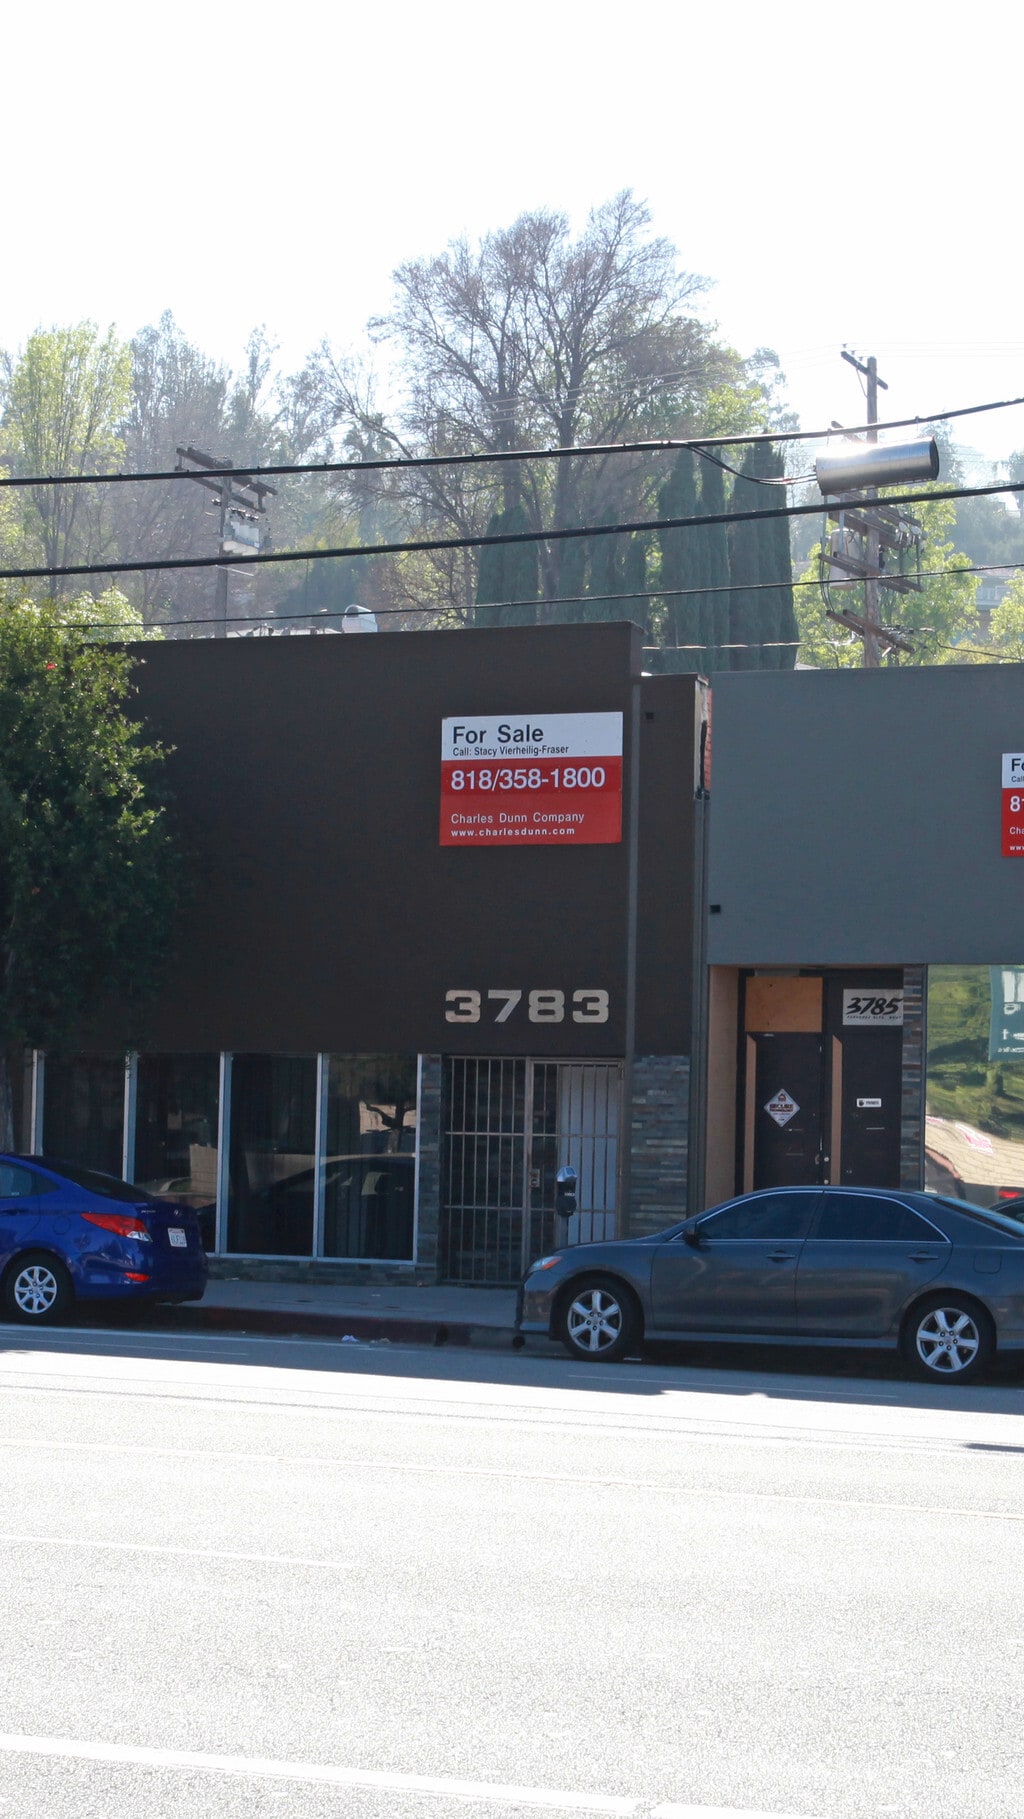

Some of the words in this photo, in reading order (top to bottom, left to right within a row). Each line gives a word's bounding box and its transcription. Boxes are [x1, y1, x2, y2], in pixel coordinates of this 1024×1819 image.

[452, 726, 487, 745] For
[497, 724, 544, 744] Sale
[452, 747, 472, 757] Call:
[474, 747, 497, 758] Stacy
[500, 745, 569, 757] Vierheilig-Fraser
[451, 767, 606, 791] 818/358-1800
[451, 813, 493, 824] Charles
[499, 813, 528, 824] Dunn
[533, 812, 585, 825] Company
[451, 827, 575, 837] www.charlesdunn.com
[445, 989, 610, 1023] 3783
[846, 997, 903, 1015] 3785
